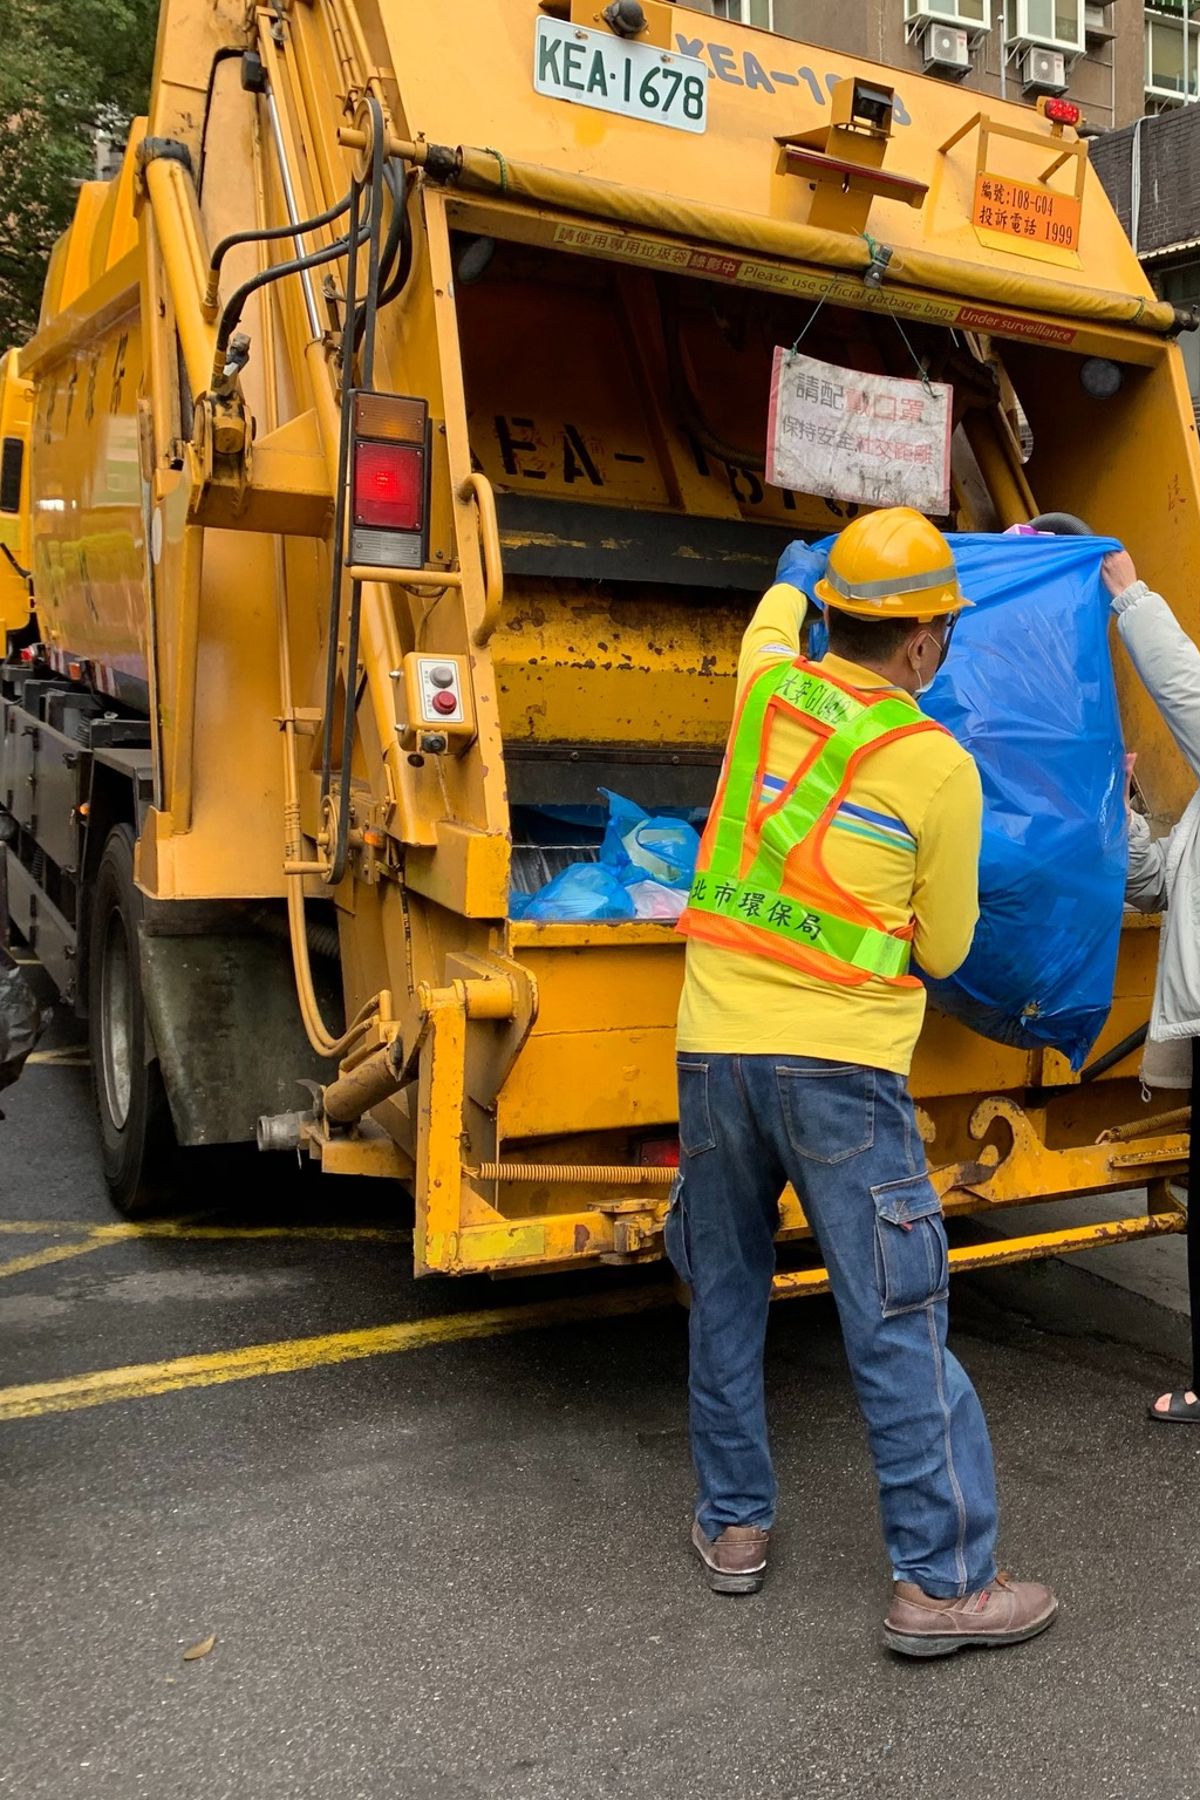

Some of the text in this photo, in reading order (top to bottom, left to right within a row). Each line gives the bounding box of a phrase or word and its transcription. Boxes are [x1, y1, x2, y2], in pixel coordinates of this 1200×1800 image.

[558, 226, 691, 266] 請使用專用垃圾袋
[980, 206, 1073, 246] 投訴電話 1999
[743, 265, 1072, 342] Please use official garbage bags Under surveillance
